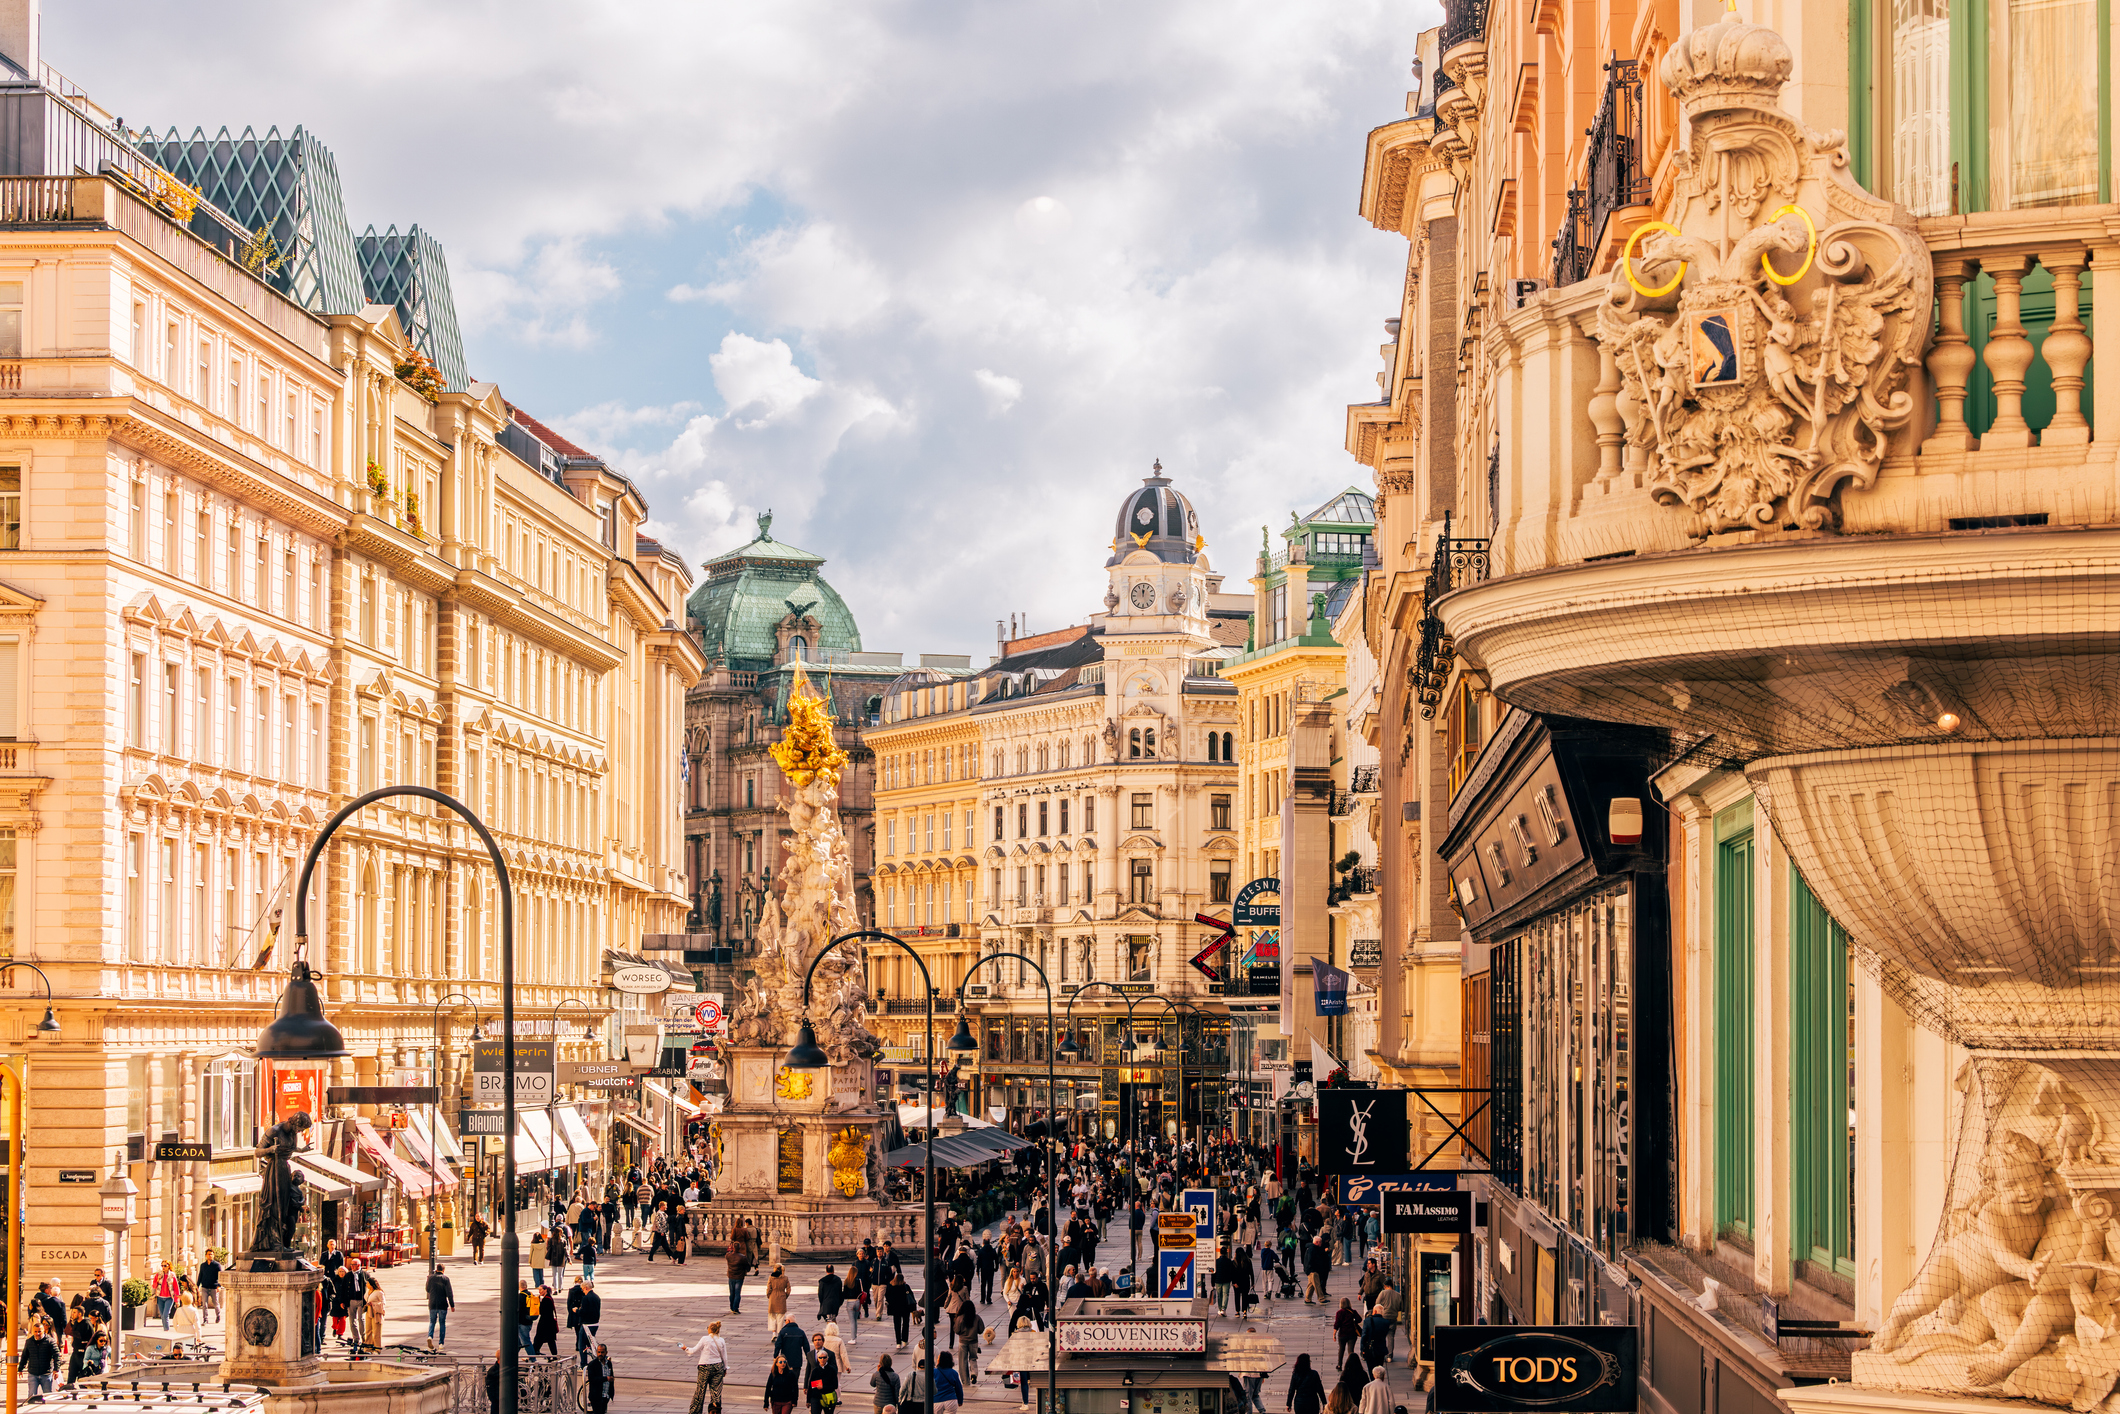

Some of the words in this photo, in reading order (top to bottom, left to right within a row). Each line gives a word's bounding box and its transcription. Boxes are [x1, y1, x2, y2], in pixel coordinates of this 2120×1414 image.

[1123, 645, 1164, 656] GENERALI
[1196, 934, 1232, 964] FLEDERMAUS
[621, 974, 662, 982] WORSEG
[672, 994, 717, 1002] JANECKA
[573, 1065, 618, 1074] HÜBNER
[836, 1067, 857, 1075] DEO
[480, 1076, 546, 1090] BRMO
[1345, 1099, 1377, 1165] YSL
[160, 1147, 206, 1157] ESCADA
[1395, 1203, 1459, 1216] FAMASSIMO
[41, 1250, 88, 1260] ESCADA
[1083, 1327, 1179, 1341] SOUVENIRS
[1492, 1357, 1578, 1383] TOD'S
